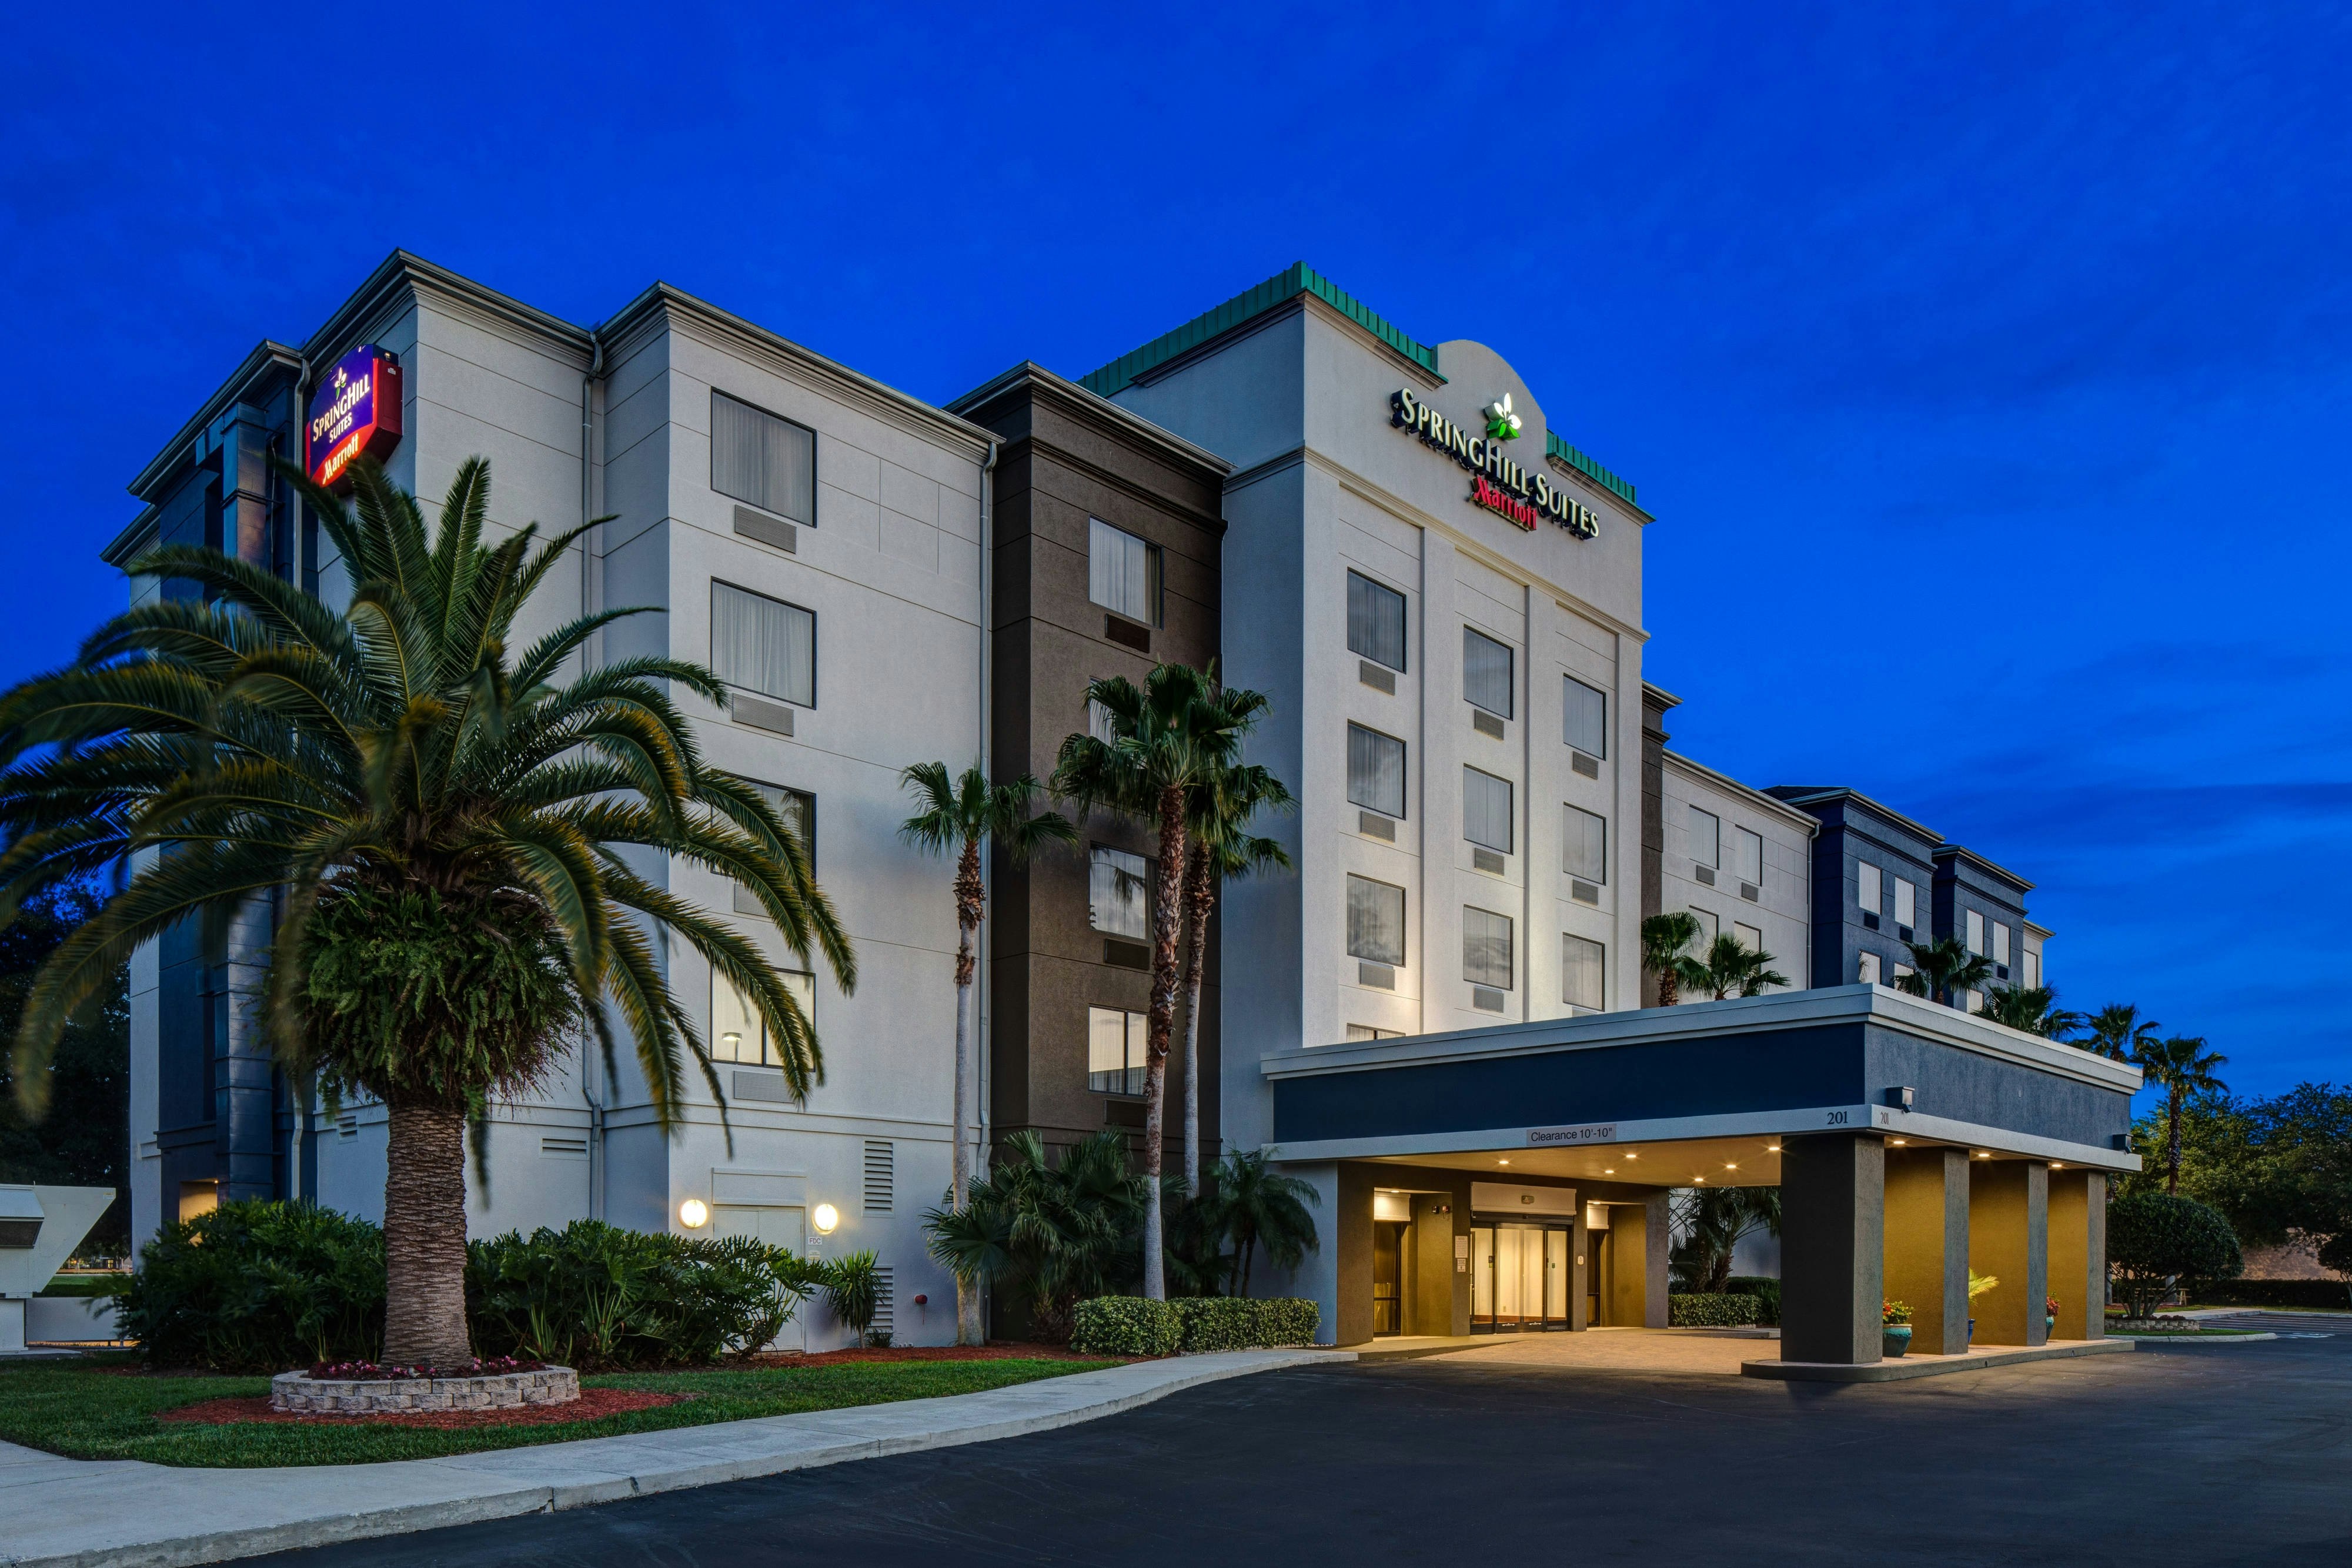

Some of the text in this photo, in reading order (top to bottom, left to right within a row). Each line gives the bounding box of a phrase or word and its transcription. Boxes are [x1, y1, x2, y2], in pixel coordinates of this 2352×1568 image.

[329, 412, 352, 444] SUITES
[322, 433, 359, 485] Marriott
[1474, 474, 1538, 530] Marriott
[1535, 472, 1599, 538] SUITES
[1827, 1111, 1849, 1125] 201
[1880, 1111, 1889, 1125] 201
[1531, 1128, 1612, 1142] Clearance 10'-10"
